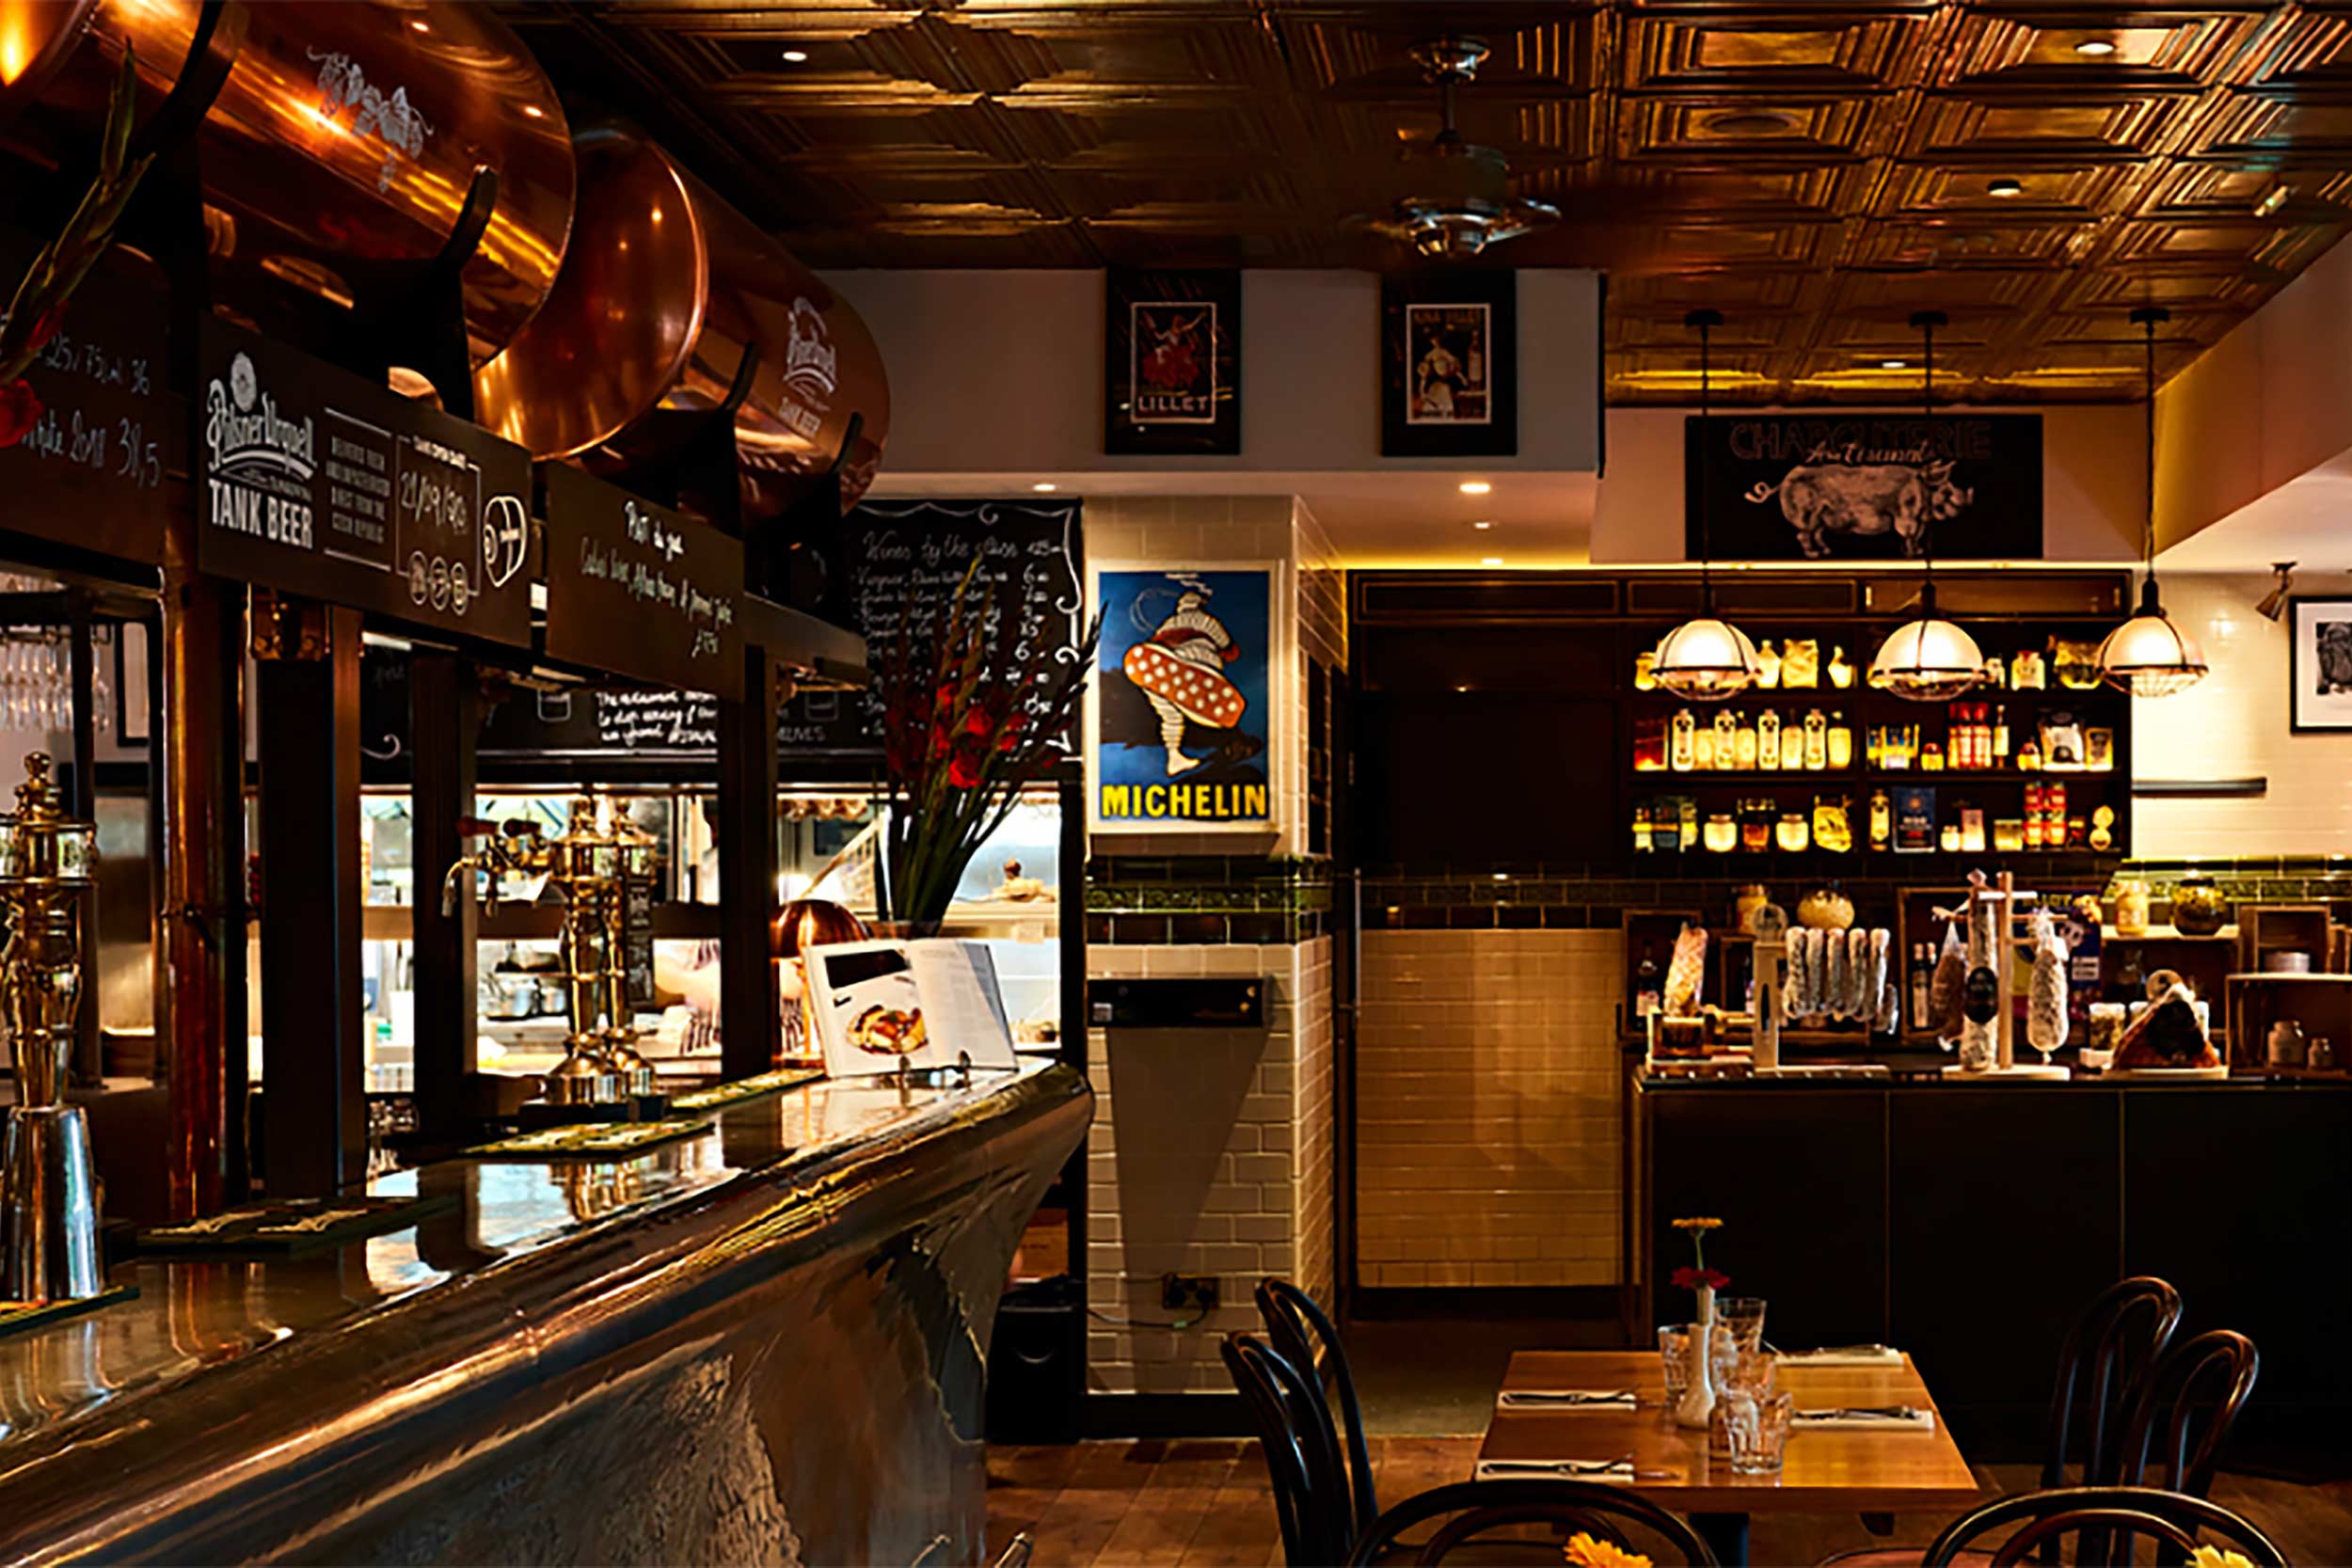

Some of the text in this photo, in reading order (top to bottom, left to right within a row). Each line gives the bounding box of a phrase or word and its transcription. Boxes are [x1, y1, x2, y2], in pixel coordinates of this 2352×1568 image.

[1138, 396, 1209, 413] LILLET
[208, 478, 262, 536] TANK
[267, 496, 314, 549] BEER
[1101, 784, 1265, 817] MICHELIN
